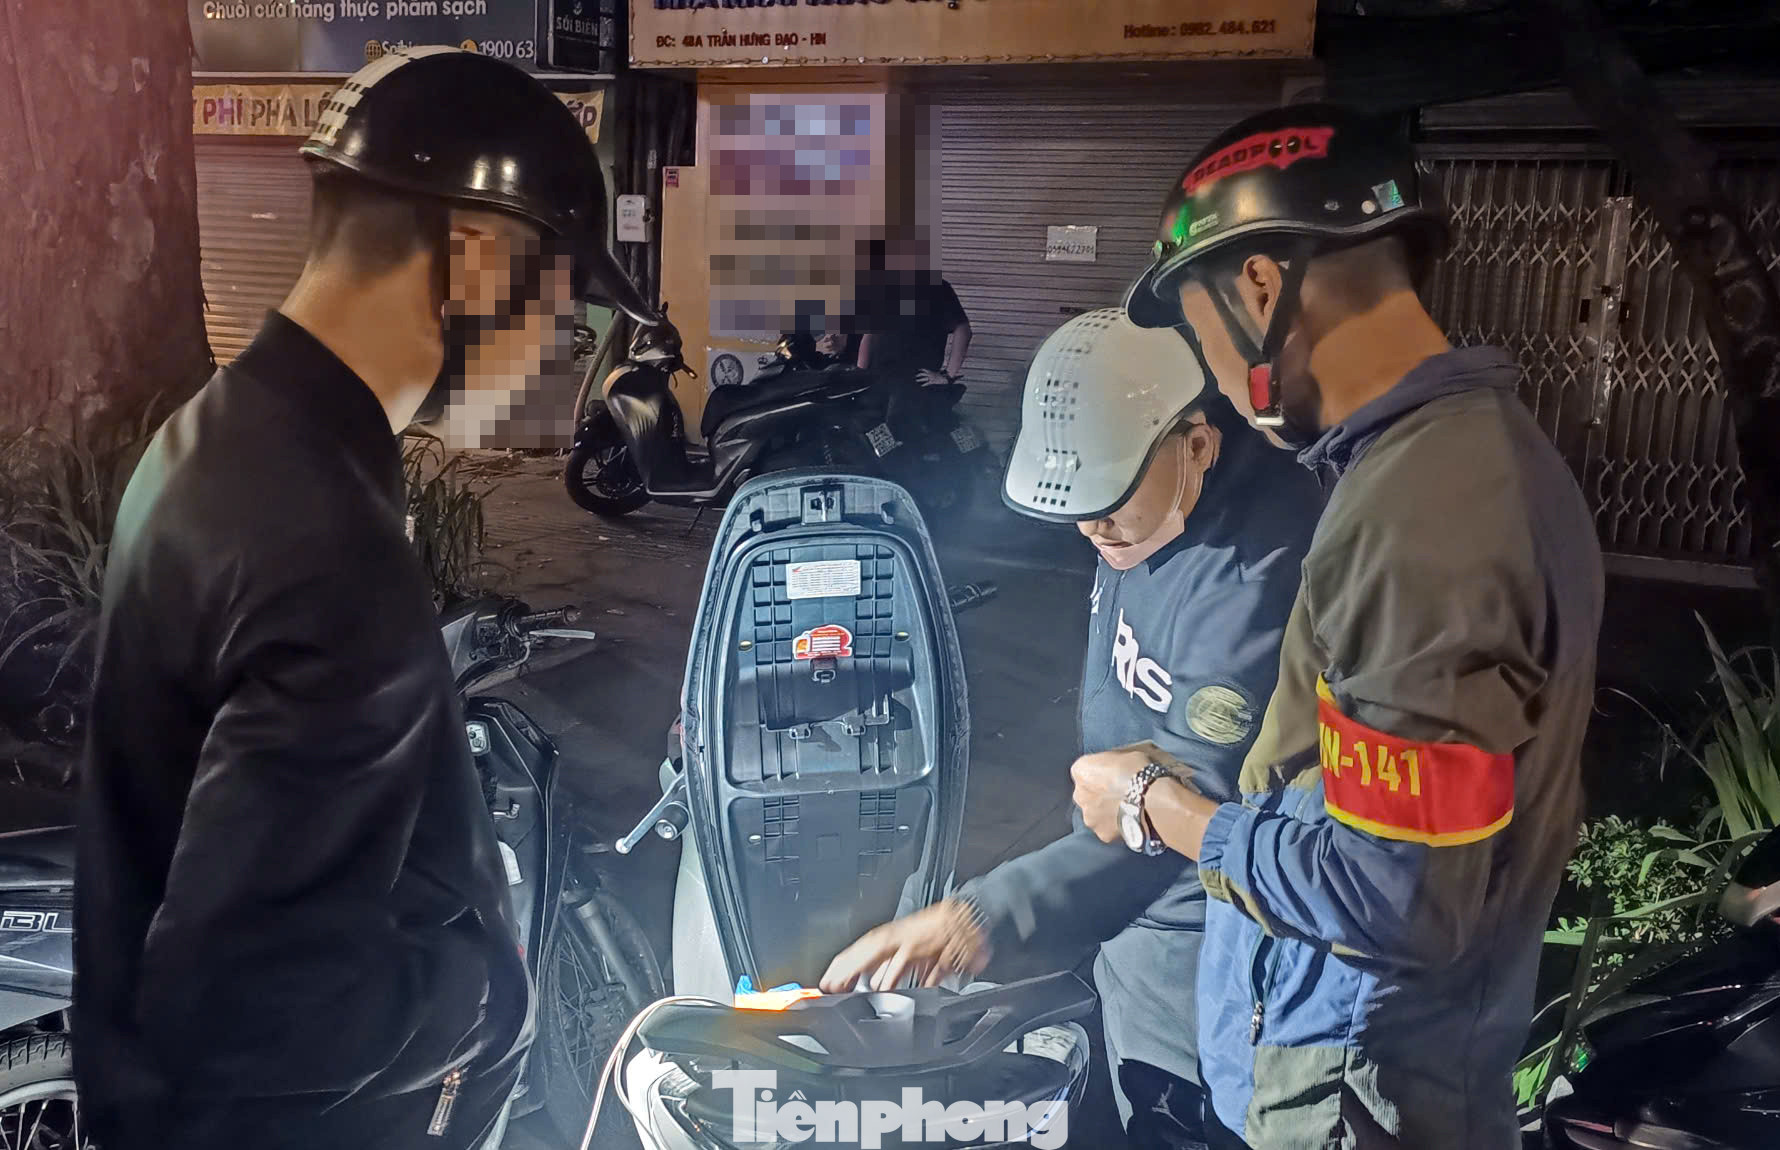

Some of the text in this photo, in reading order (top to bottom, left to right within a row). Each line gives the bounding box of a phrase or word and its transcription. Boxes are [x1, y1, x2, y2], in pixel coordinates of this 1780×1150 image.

[740, 32, 771, 47] HƯNG
[810, 32, 826, 46] HN
[479, 40, 514, 58] 1900
[1193, 136, 1320, 181] DEADPOOL
